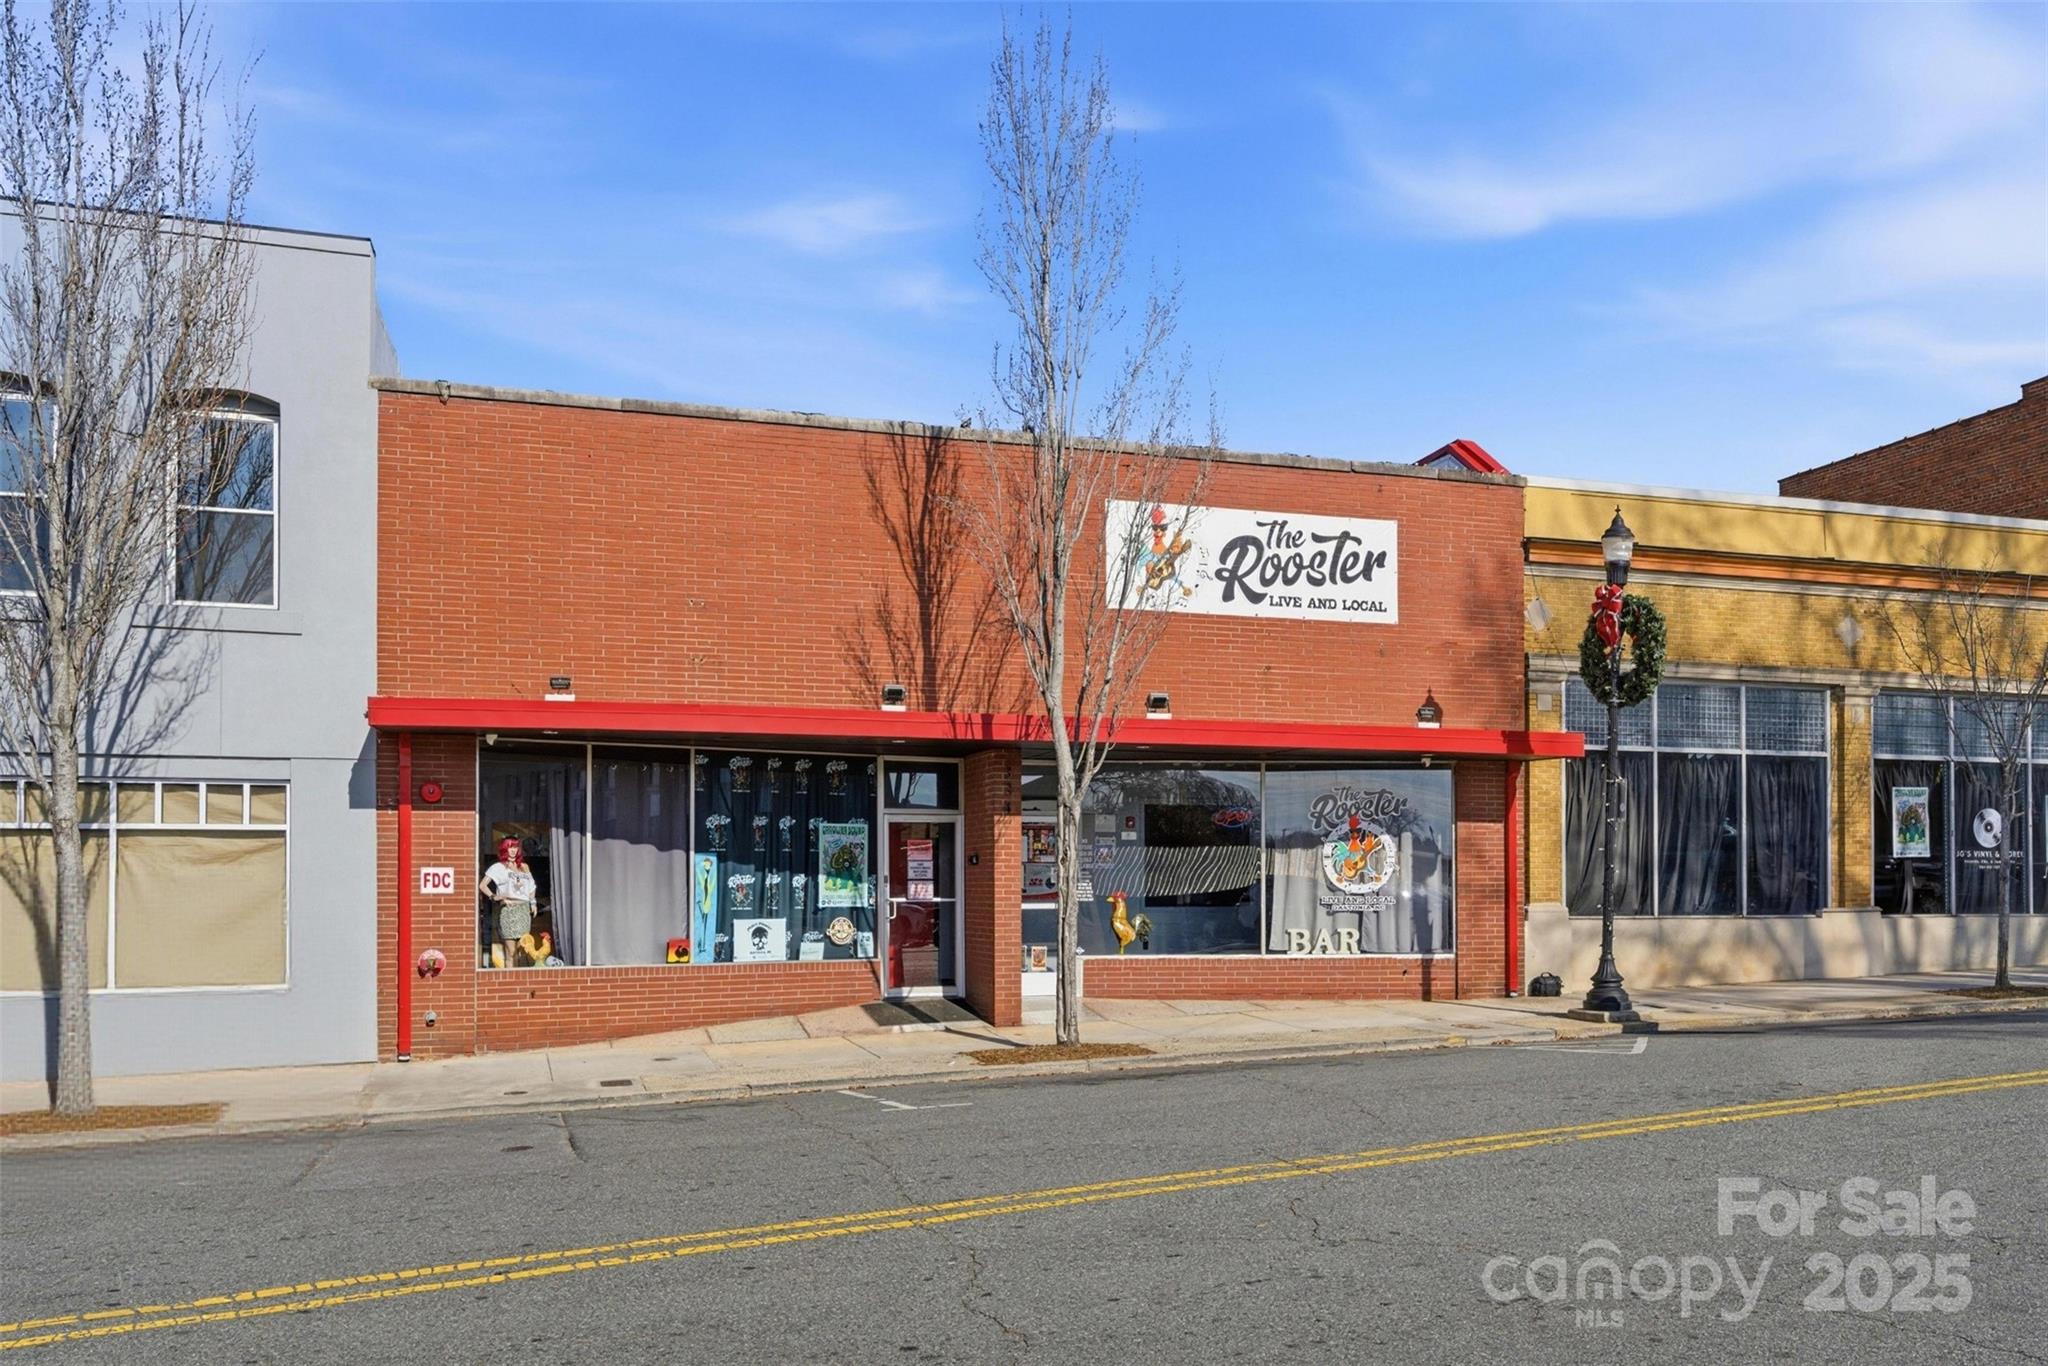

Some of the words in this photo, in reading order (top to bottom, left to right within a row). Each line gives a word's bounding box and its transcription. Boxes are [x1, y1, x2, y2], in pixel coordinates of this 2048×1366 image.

[1256, 520, 1306, 548] The
[1215, 530, 1386, 604] Rooster
[1269, 595, 1302, 608] LIVE
[1307, 597, 1337, 610] AND
[1342, 599, 1387, 612] LOCAL
[1334, 785, 1361, 801] The
[1309, 789, 1408, 831] Rooster
[423, 872, 451, 889] FDC
[1286, 928, 1360, 954] BAR
